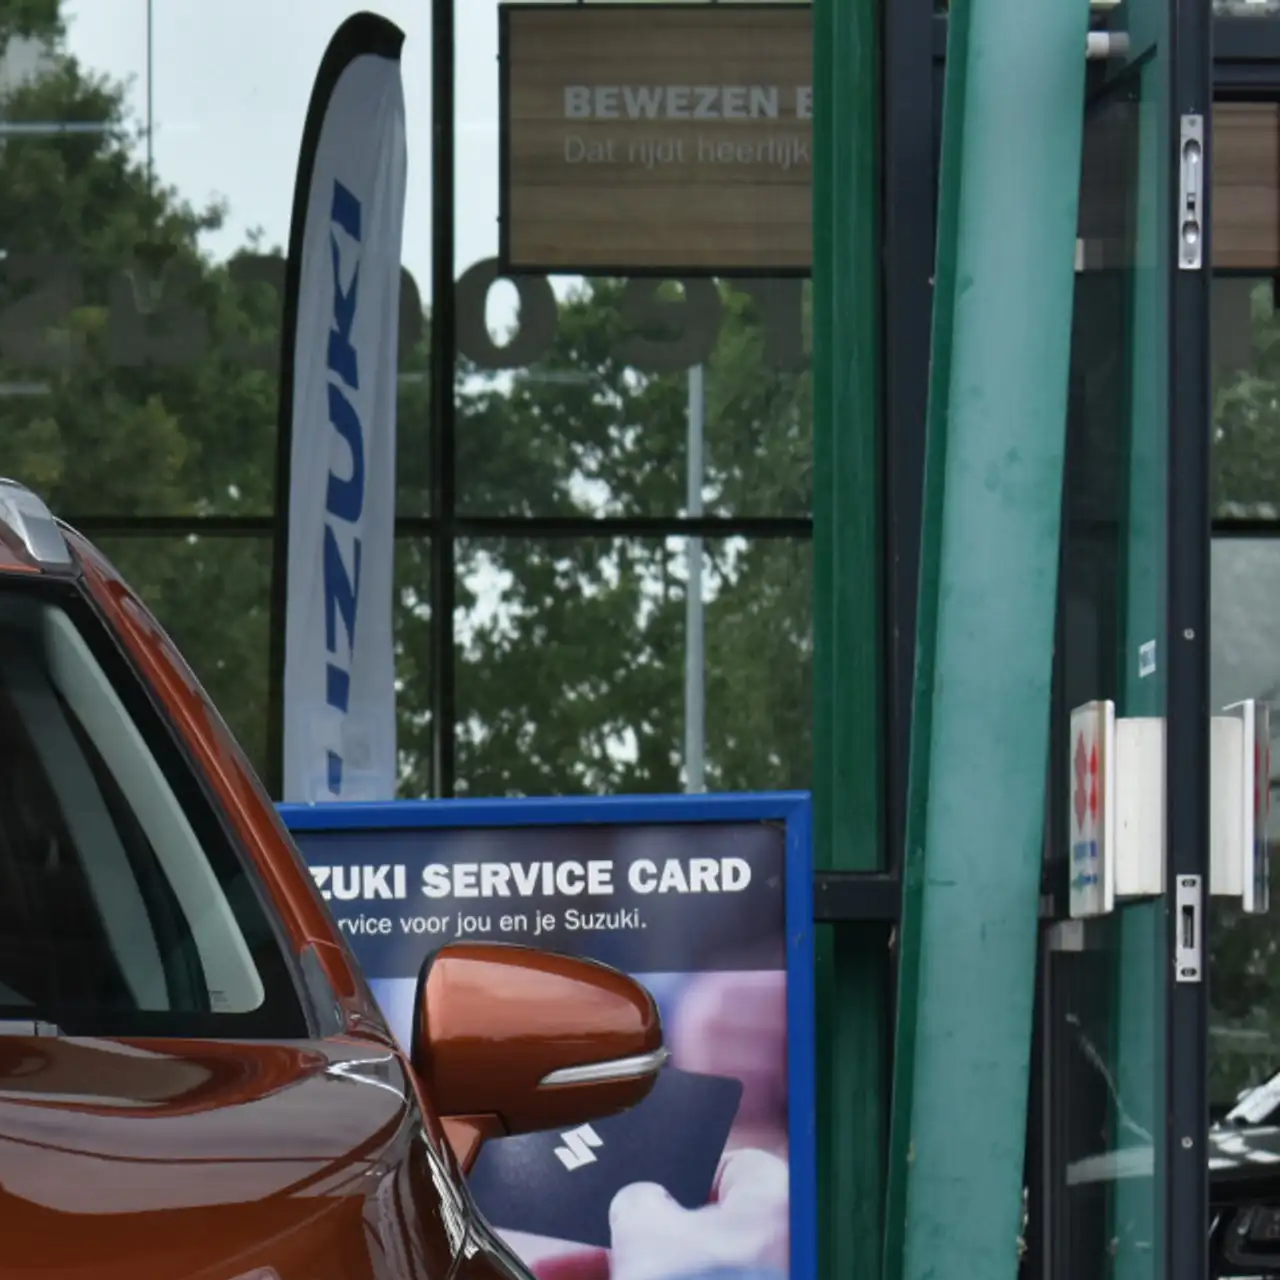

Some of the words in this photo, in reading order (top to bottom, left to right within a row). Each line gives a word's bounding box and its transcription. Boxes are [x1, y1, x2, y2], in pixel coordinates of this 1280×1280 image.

[564, 85, 779, 120] BEWEZEN
[564, 136, 617, 164] Dat
[629, 136, 685, 170] rijdt
[698, 136, 810, 171] heerlijk
[421, 861, 614, 898] SERVICE
[628, 857, 752, 894] CARD
[399, 914, 450, 934] voor
[455, 911, 491, 938] jou
[500, 911, 528, 930] en
[534, 911, 557, 936] je
[564, 908, 647, 931] Suzuki.
